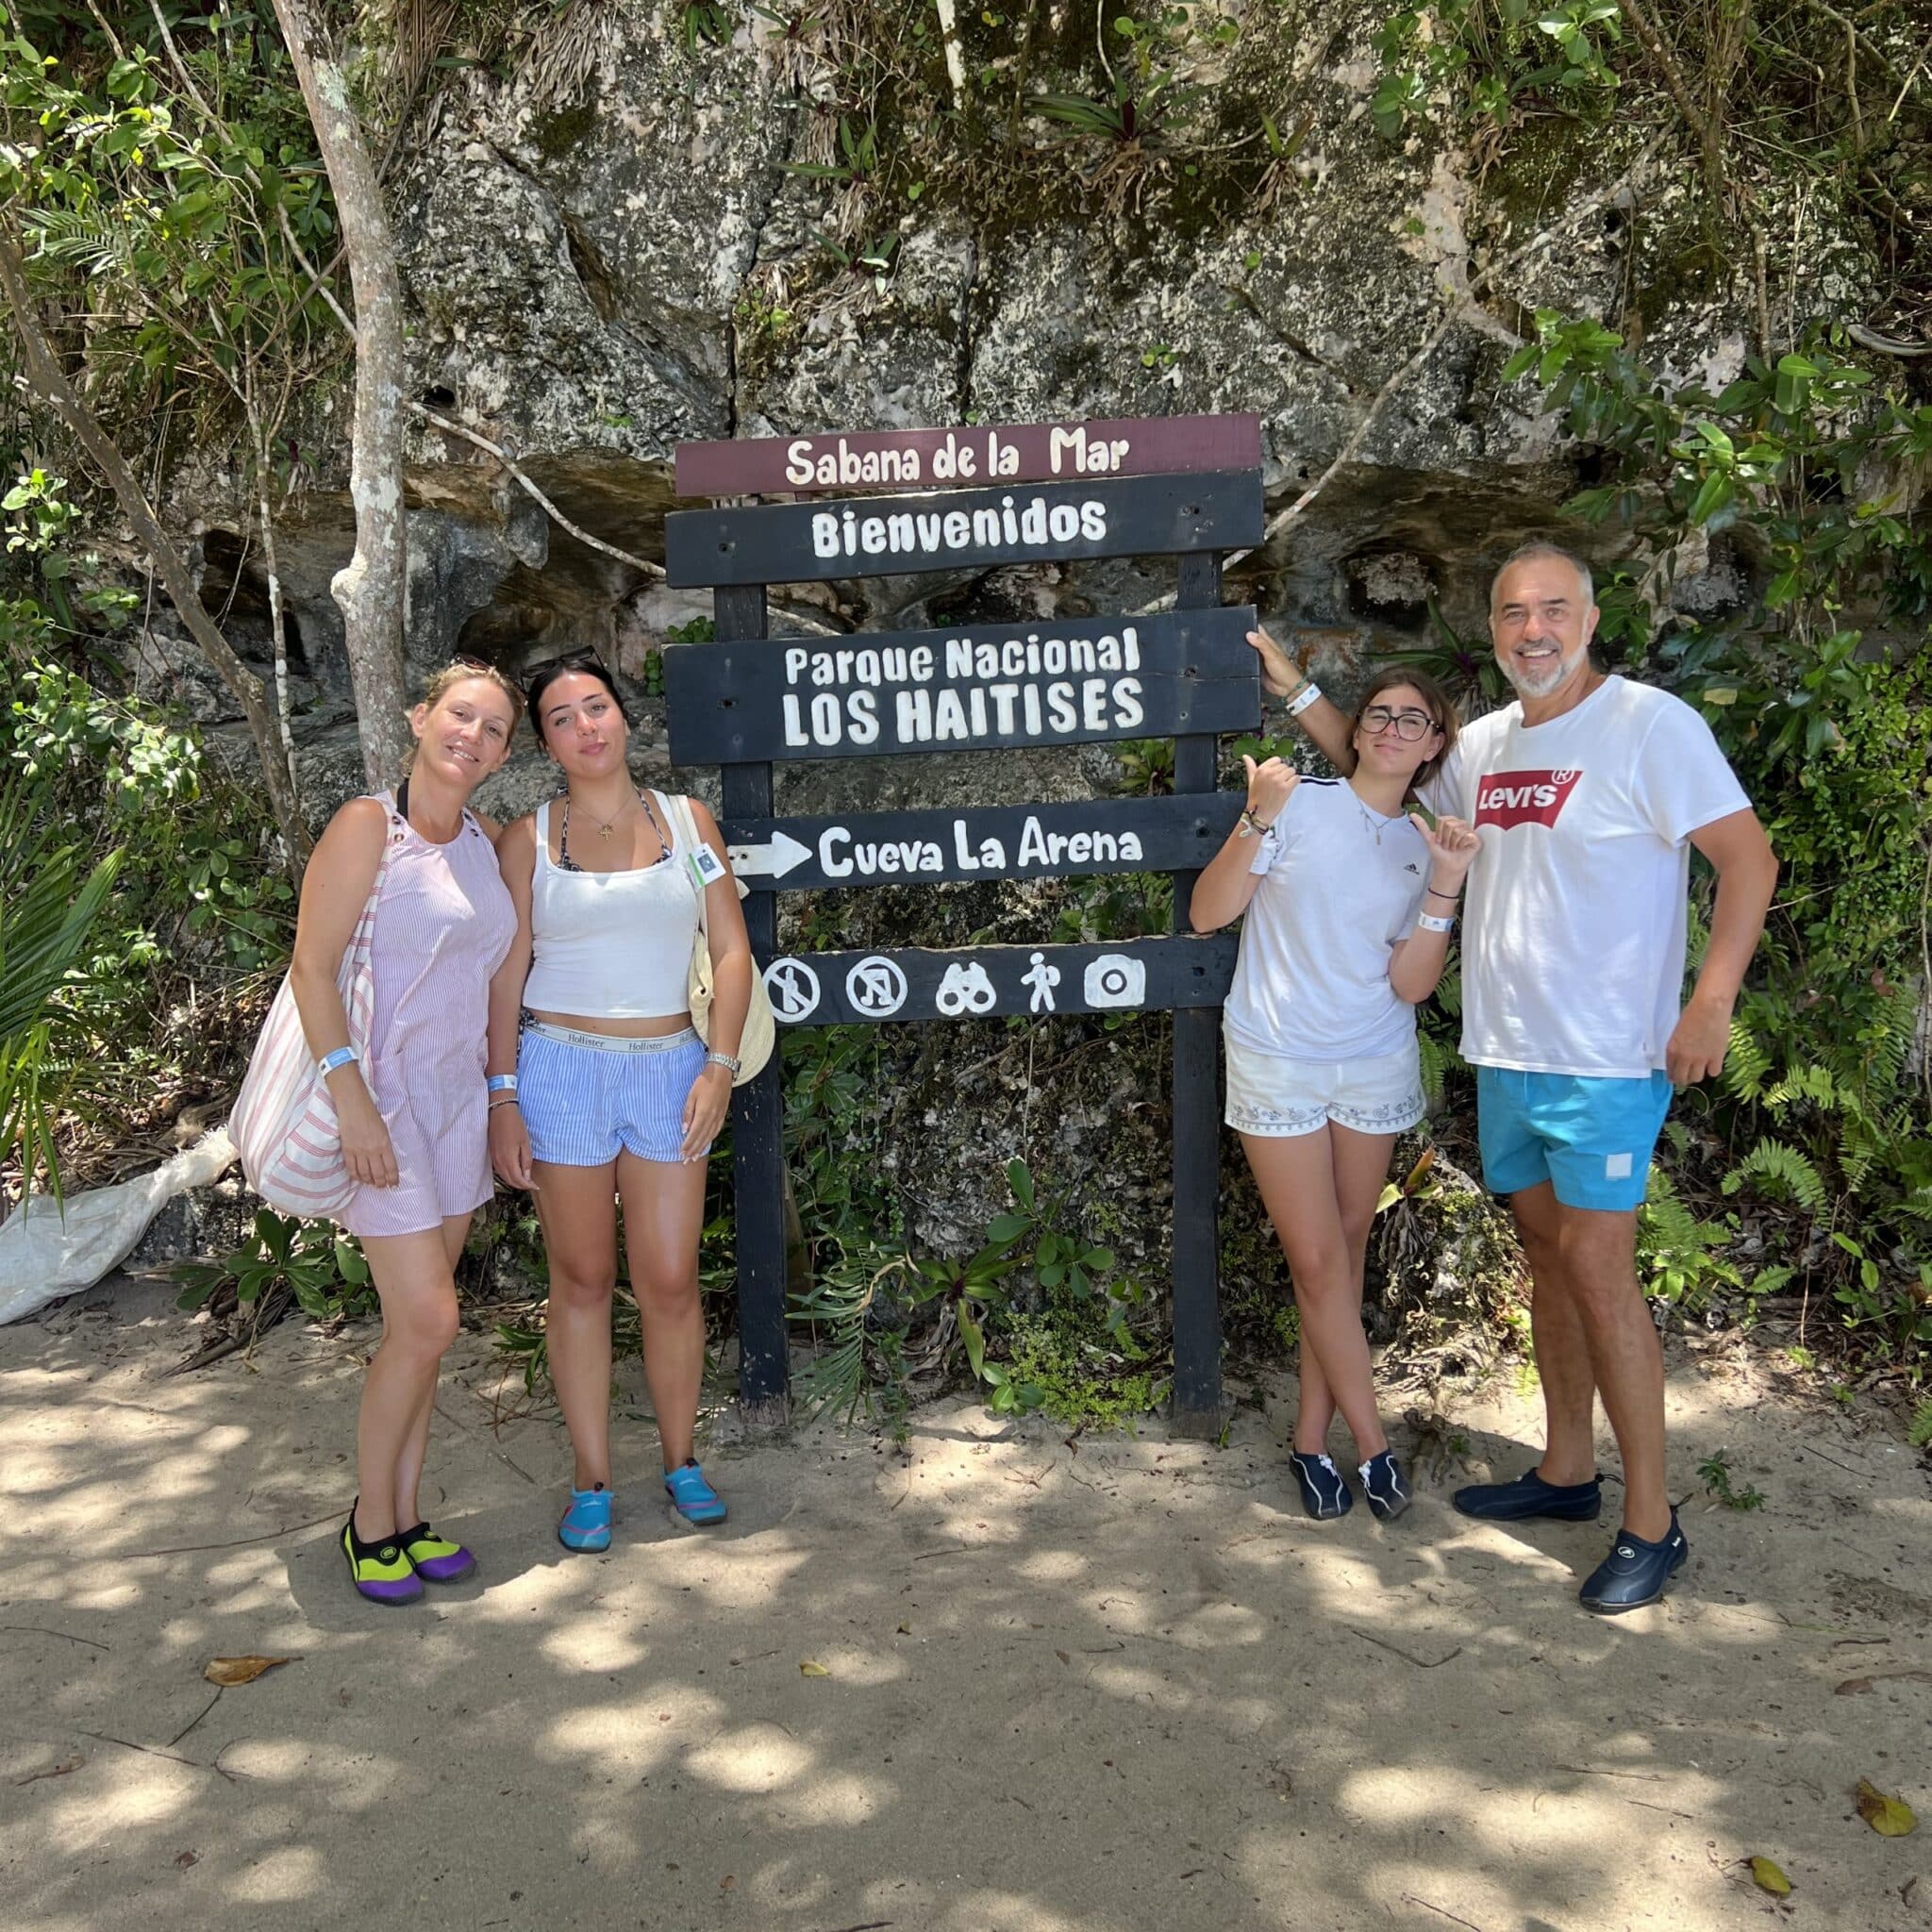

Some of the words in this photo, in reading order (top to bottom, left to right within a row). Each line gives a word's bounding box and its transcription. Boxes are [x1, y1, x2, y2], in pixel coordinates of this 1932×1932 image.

[785, 438, 921, 486] Sabana
[932, 432, 977, 479] de
[988, 430, 1020, 477] la
[1049, 425, 1130, 475] Mar
[811, 495, 1108, 558] Bienvenidos
[785, 645, 934, 687] Parque
[945, 626, 1141, 679] Nacional
[782, 689, 880, 747] LOS
[895, 676, 1144, 743] HAITISES
[818, 826, 944, 877] Cueva
[953, 819, 1007, 871] La
[1017, 815, 1143, 867] Arena
[568, 1033, 605, 1048] Hollister
[628, 1041, 665, 1051] Hollister
